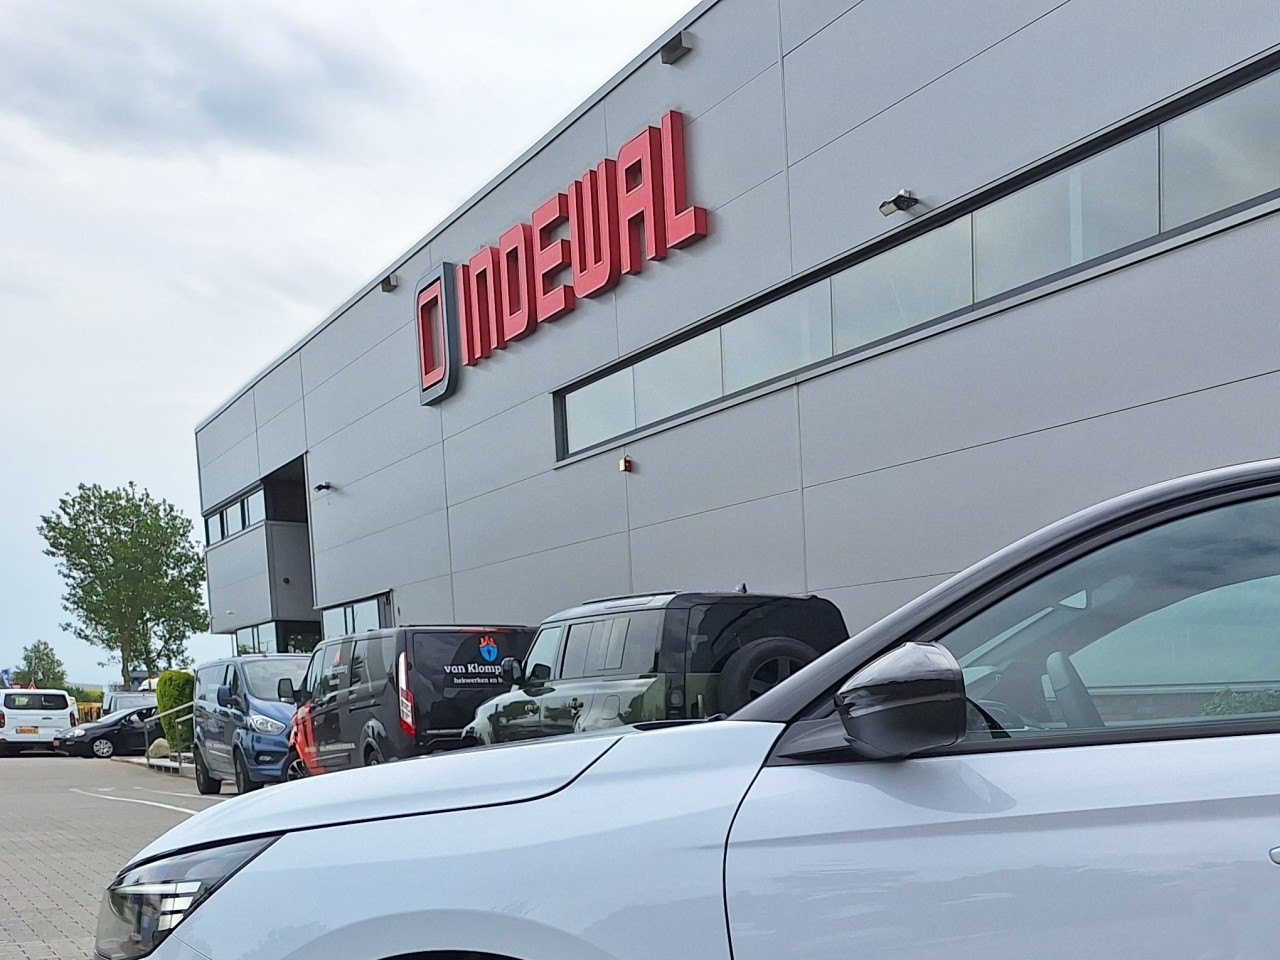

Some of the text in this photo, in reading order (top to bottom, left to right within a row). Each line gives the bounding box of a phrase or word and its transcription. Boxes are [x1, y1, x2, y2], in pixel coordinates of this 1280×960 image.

[456, 109, 708, 367] INDEWAL
[443, 665, 466, 674] van
[453, 676, 489, 684] hekwerken
